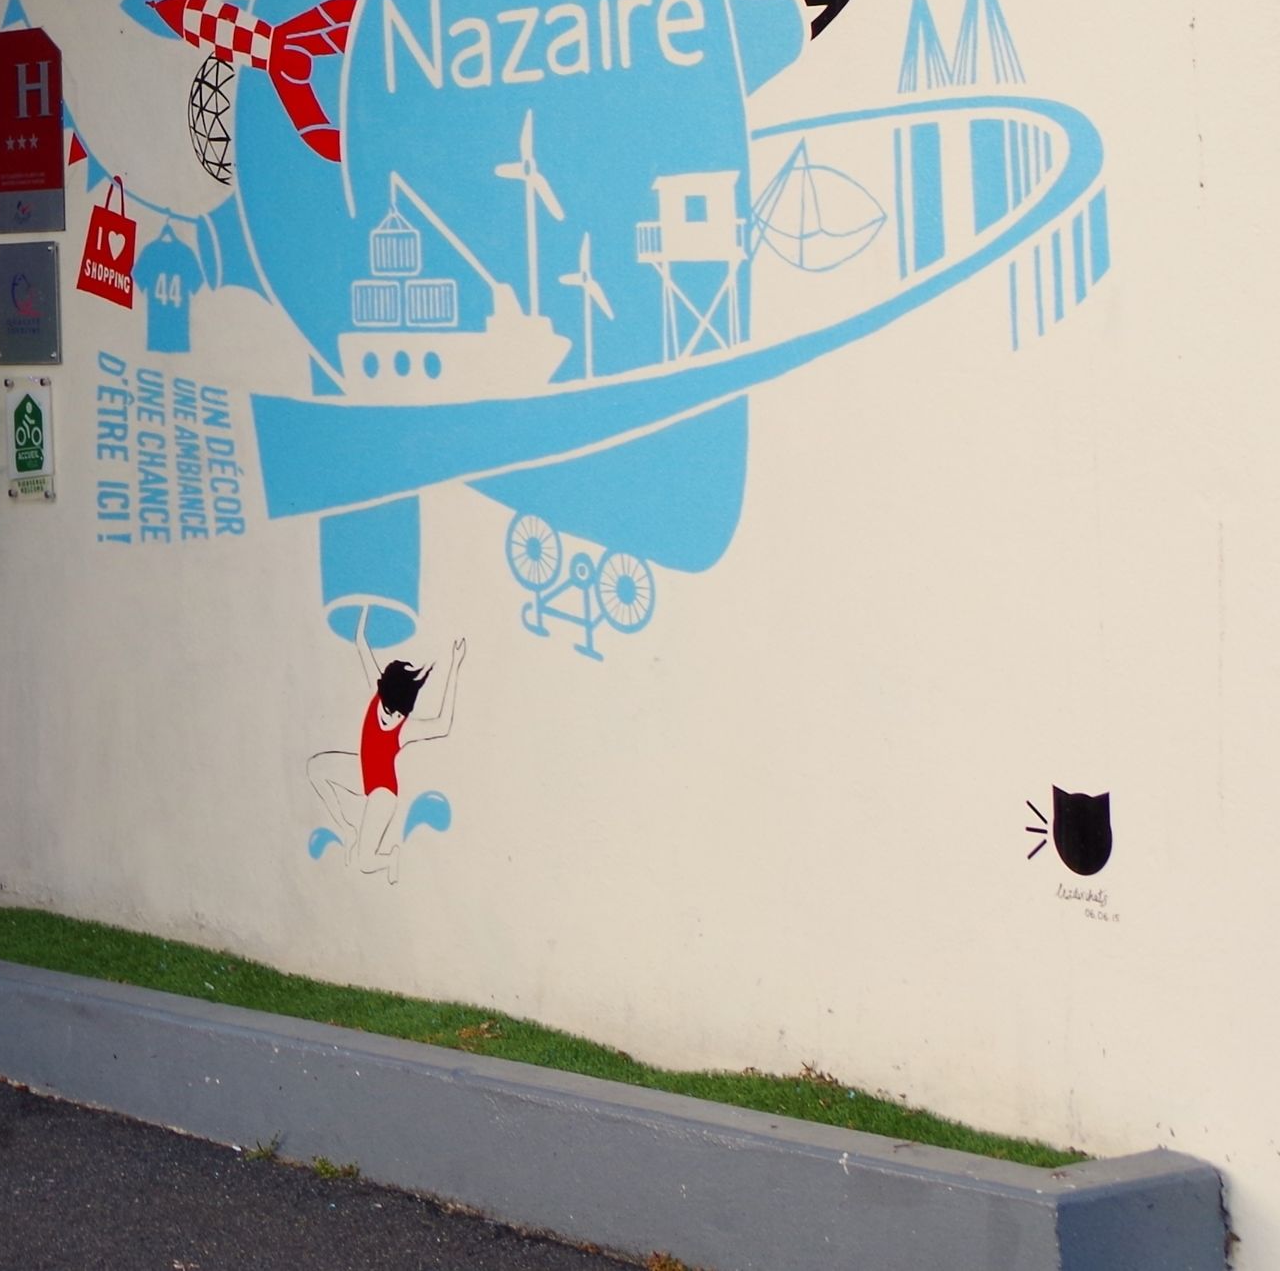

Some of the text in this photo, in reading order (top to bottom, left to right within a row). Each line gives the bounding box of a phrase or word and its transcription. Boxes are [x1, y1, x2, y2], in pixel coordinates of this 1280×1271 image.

[13, 60, 53, 120] H
[84, 226, 131, 294] I SHOPPING
[154, 272, 182, 309] 44
[96, 350, 136, 463] D'ÊTRE
[135, 367, 172, 544] UNE CHANCE
[173, 377, 210, 541] UNE AMBIANCE
[199, 385, 247, 537] UN DÉCOR
[96, 481, 131, 521] ICI
